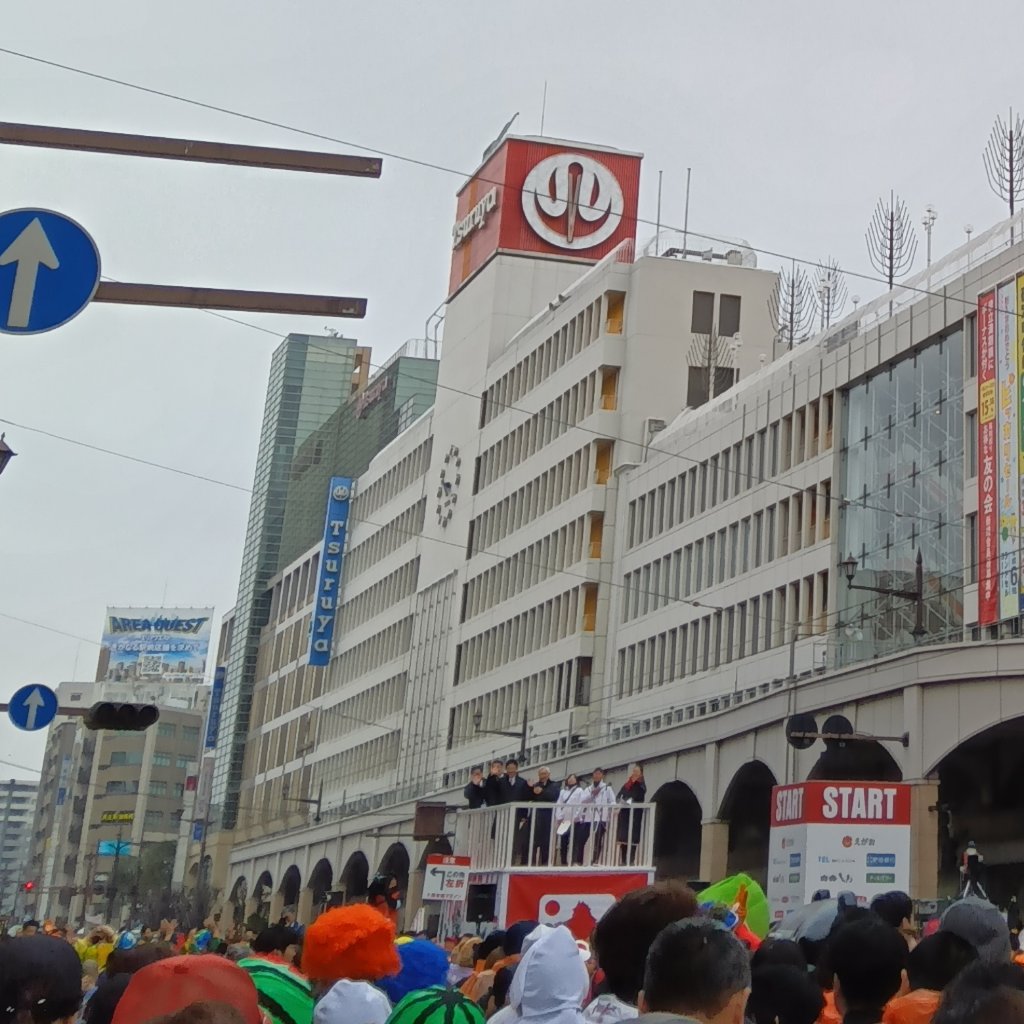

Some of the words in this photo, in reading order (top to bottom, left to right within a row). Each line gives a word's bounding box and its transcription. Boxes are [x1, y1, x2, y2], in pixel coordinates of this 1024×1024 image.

[314, 519, 345, 654] Tsuruya
[109, 615, 152, 635] AREA
[153, 615, 209, 635] QUEST
[776, 787, 804, 822] START
[822, 786, 897, 820] START
[854, 837, 876, 847] えがお
[446, 879, 465, 889] 左折
